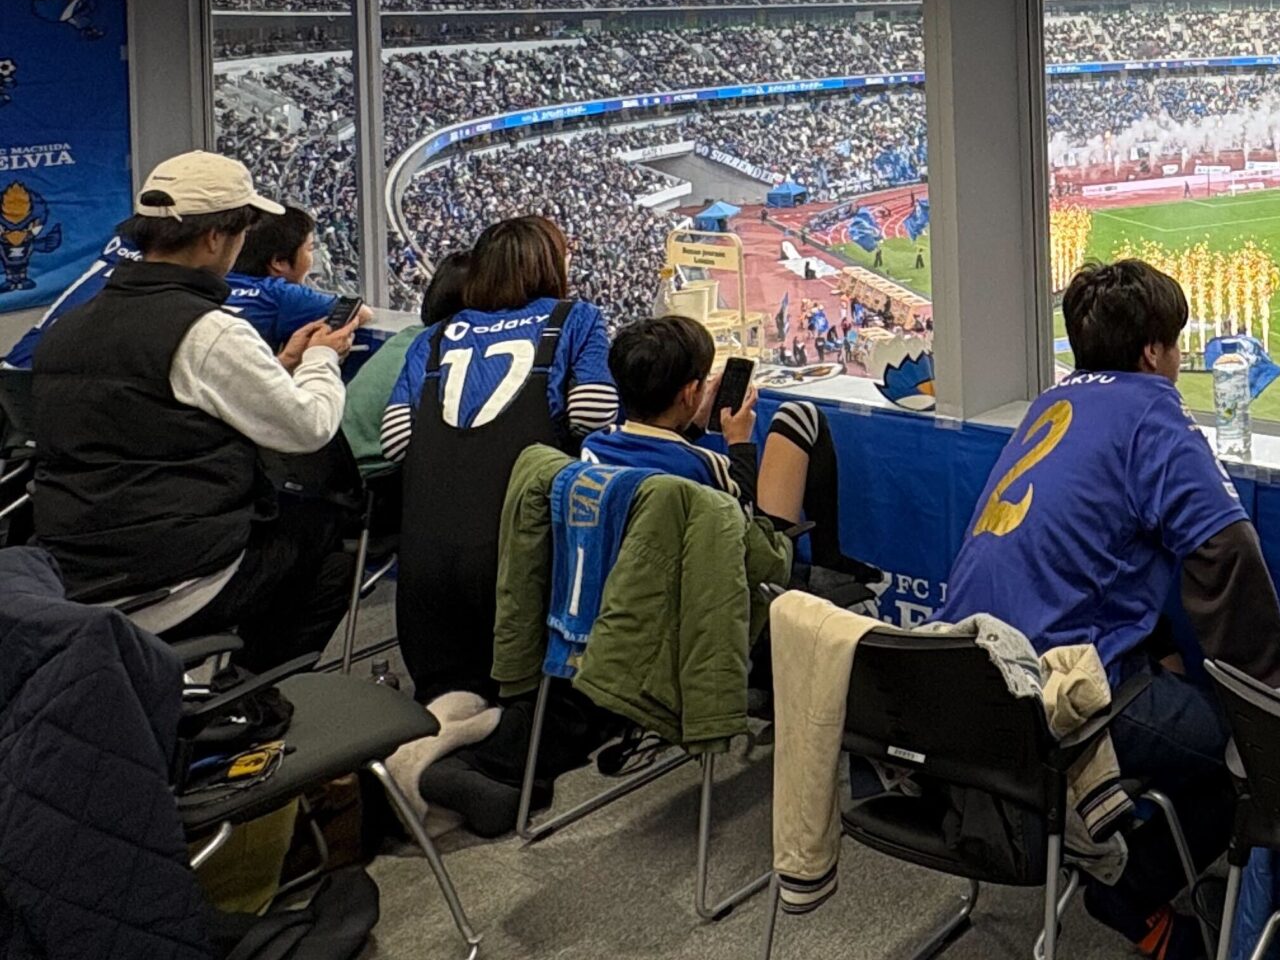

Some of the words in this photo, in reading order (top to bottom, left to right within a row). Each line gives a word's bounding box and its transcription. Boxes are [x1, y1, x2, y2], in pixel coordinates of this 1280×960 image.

[11, 142, 72, 155] MACHIDA
[439, 339, 536, 428] 17
[972, 399, 1073, 537] 2
[895, 573, 930, 599] FC
